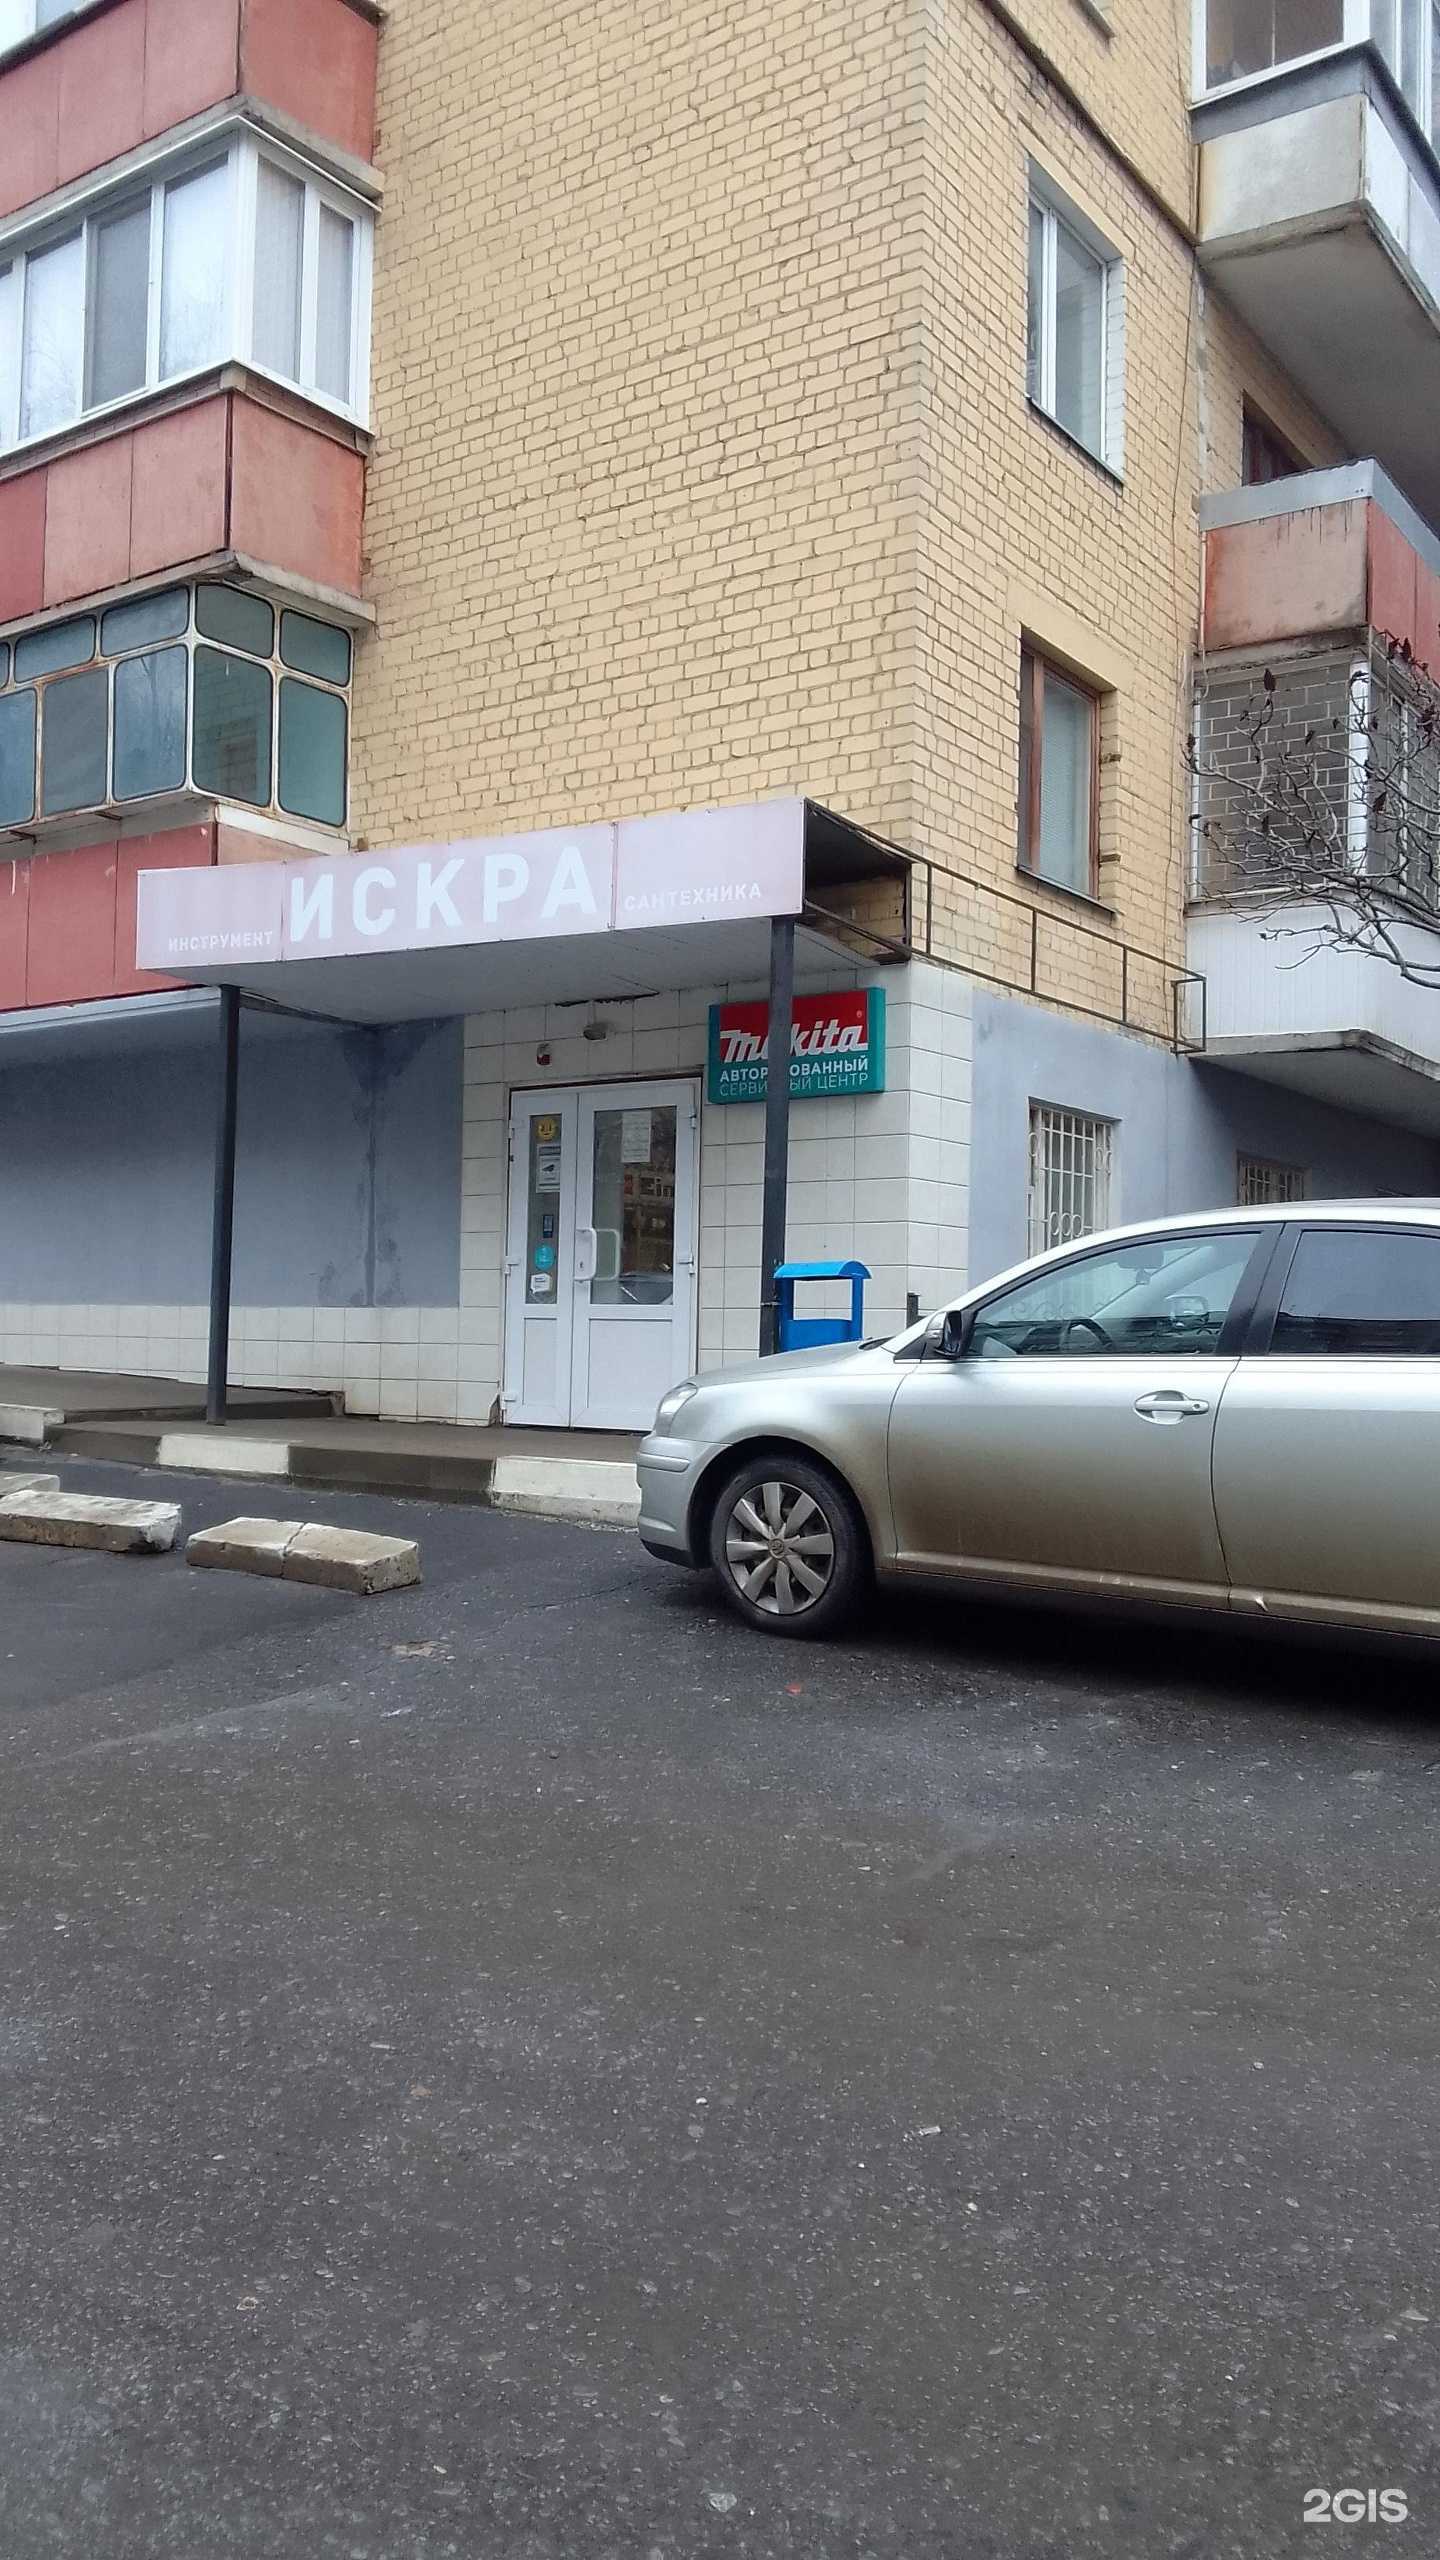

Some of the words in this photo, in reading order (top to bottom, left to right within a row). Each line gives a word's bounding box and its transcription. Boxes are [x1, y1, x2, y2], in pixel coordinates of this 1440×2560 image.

[290, 846, 598, 942] ИСКРА
[624, 882, 762, 911] САНТЕХНИКА
[168, 930, 273, 952] ИНСТРУМЕНТ
[720, 1055, 868, 1082] АВТОРОВАННЫЙ
[720, 1075, 811, 1097] СЕРВИЫЙ
[817, 1072, 869, 1089] ЦЕНТР
